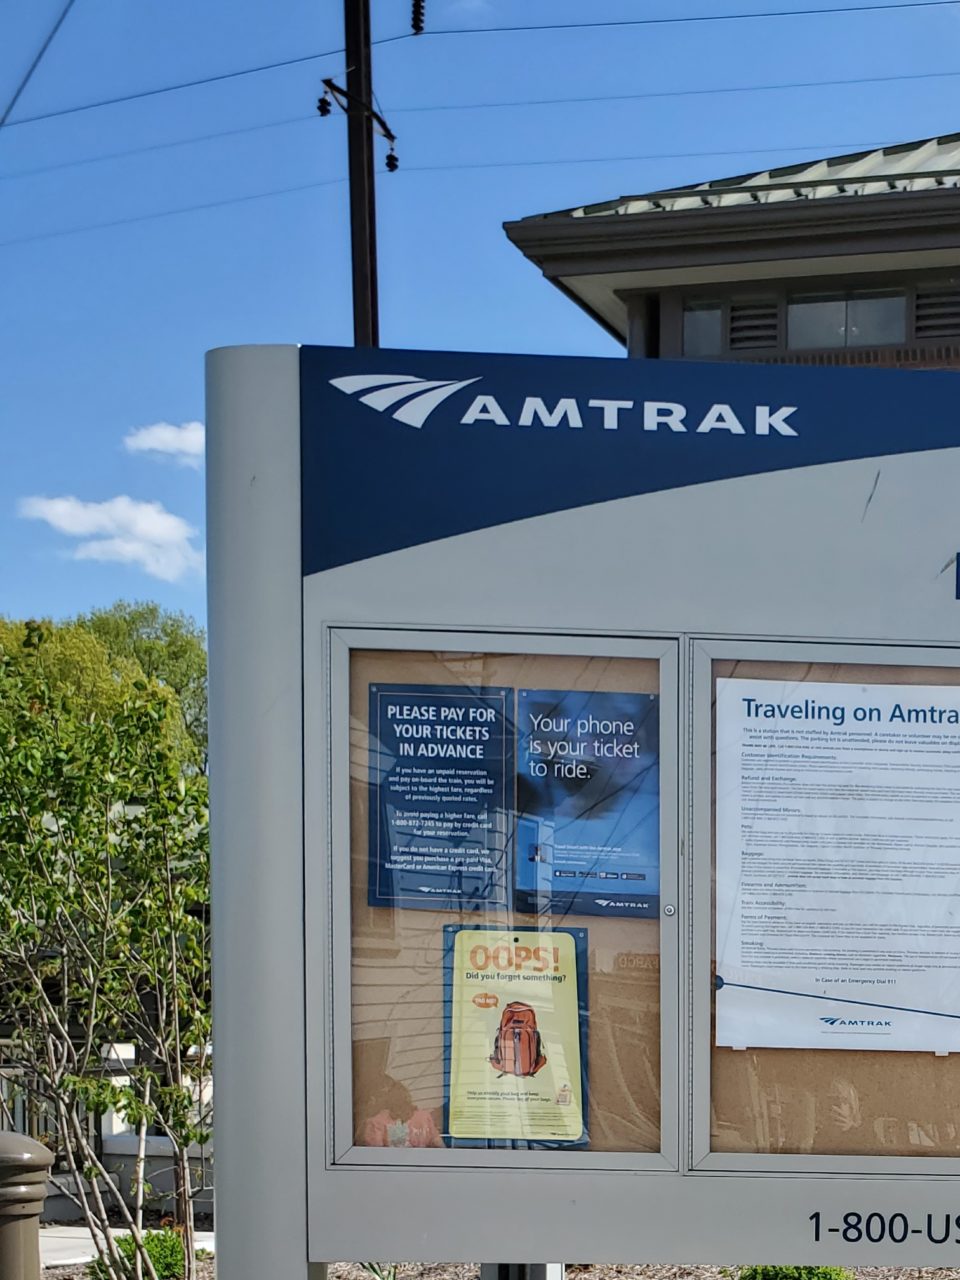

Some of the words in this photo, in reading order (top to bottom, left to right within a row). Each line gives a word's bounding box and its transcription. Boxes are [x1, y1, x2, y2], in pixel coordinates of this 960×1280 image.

[460, 395, 799, 436] AMTRAK
[387, 705, 437, 720] PLEASE
[441, 707, 465, 721] PAY
[470, 708, 496, 722] FOR
[742, 698, 845, 726] Traveling
[854, 707, 881, 722] on
[394, 724, 431, 738] YOUR
[435, 726, 489, 740] TICKETS
[530, 714, 571, 732] Your
[578, 715, 634, 737] phone
[400, 743, 414, 756] IN
[418, 743, 484, 759] ADVANCE
[530, 736, 541, 754] is
[548, 740, 587, 760] your
[593, 739, 640, 758] ticket
[529, 760, 547, 776] to
[555, 760, 591, 779] ride.
[470, 945, 560, 972] OOPS!
[481, 973, 495, 981] you
[497, 973, 520, 981] forget
[523, 974, 566, 983] something?
